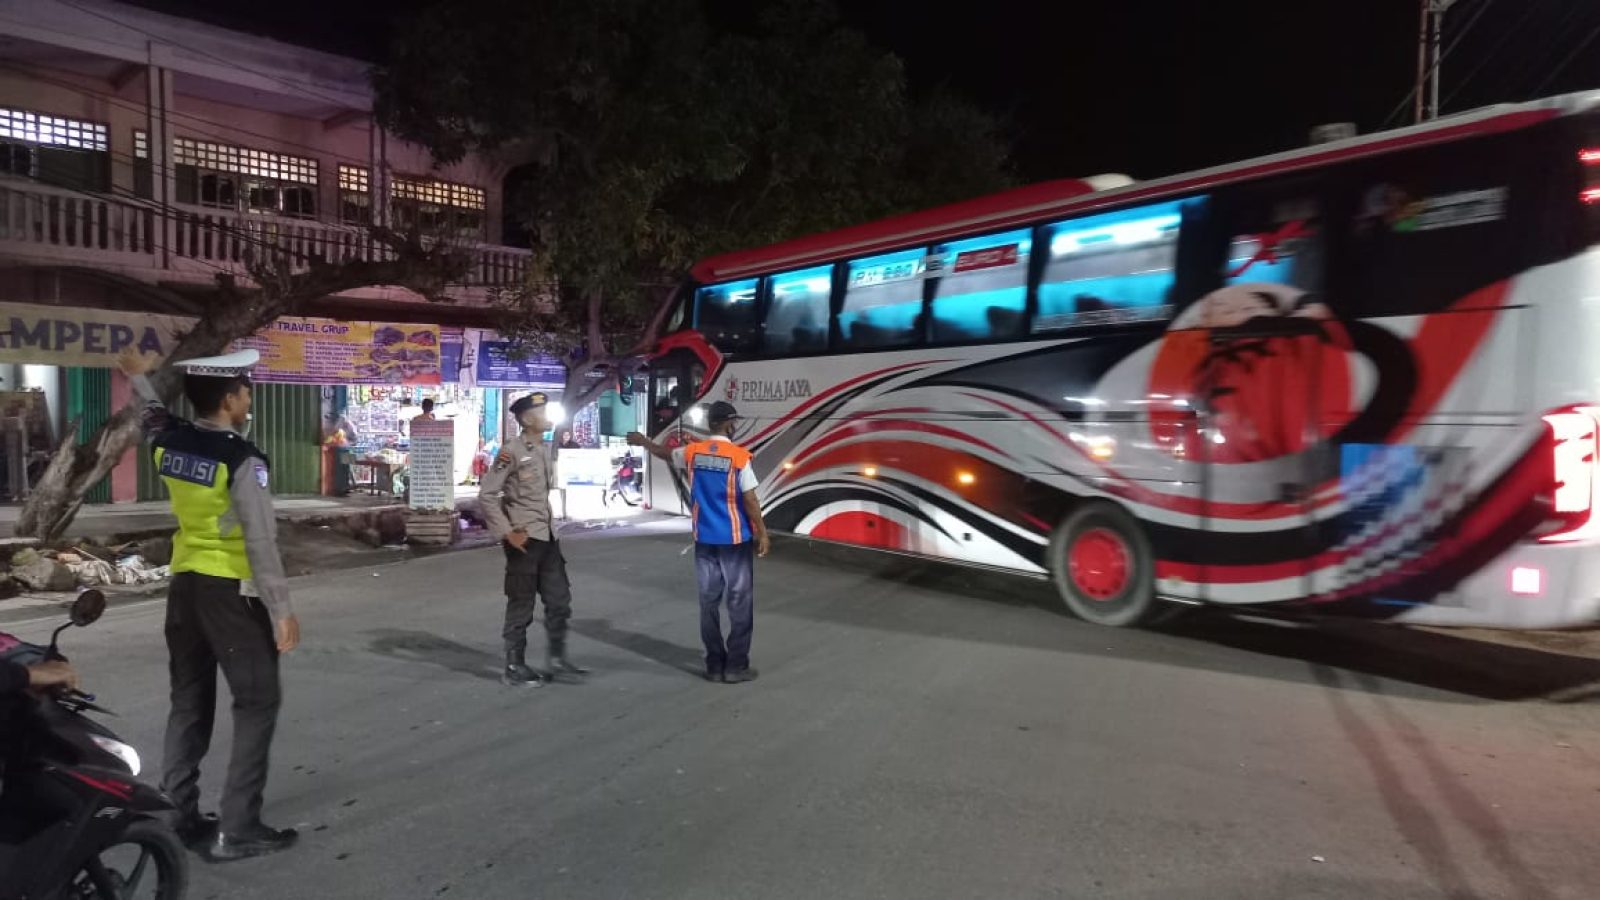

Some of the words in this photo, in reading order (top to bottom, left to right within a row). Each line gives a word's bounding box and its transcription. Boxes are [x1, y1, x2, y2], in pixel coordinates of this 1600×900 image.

[277, 321, 318, 333] TRAVEL
[321, 324, 349, 335] GRUP
[161, 453, 216, 482] POLISI
